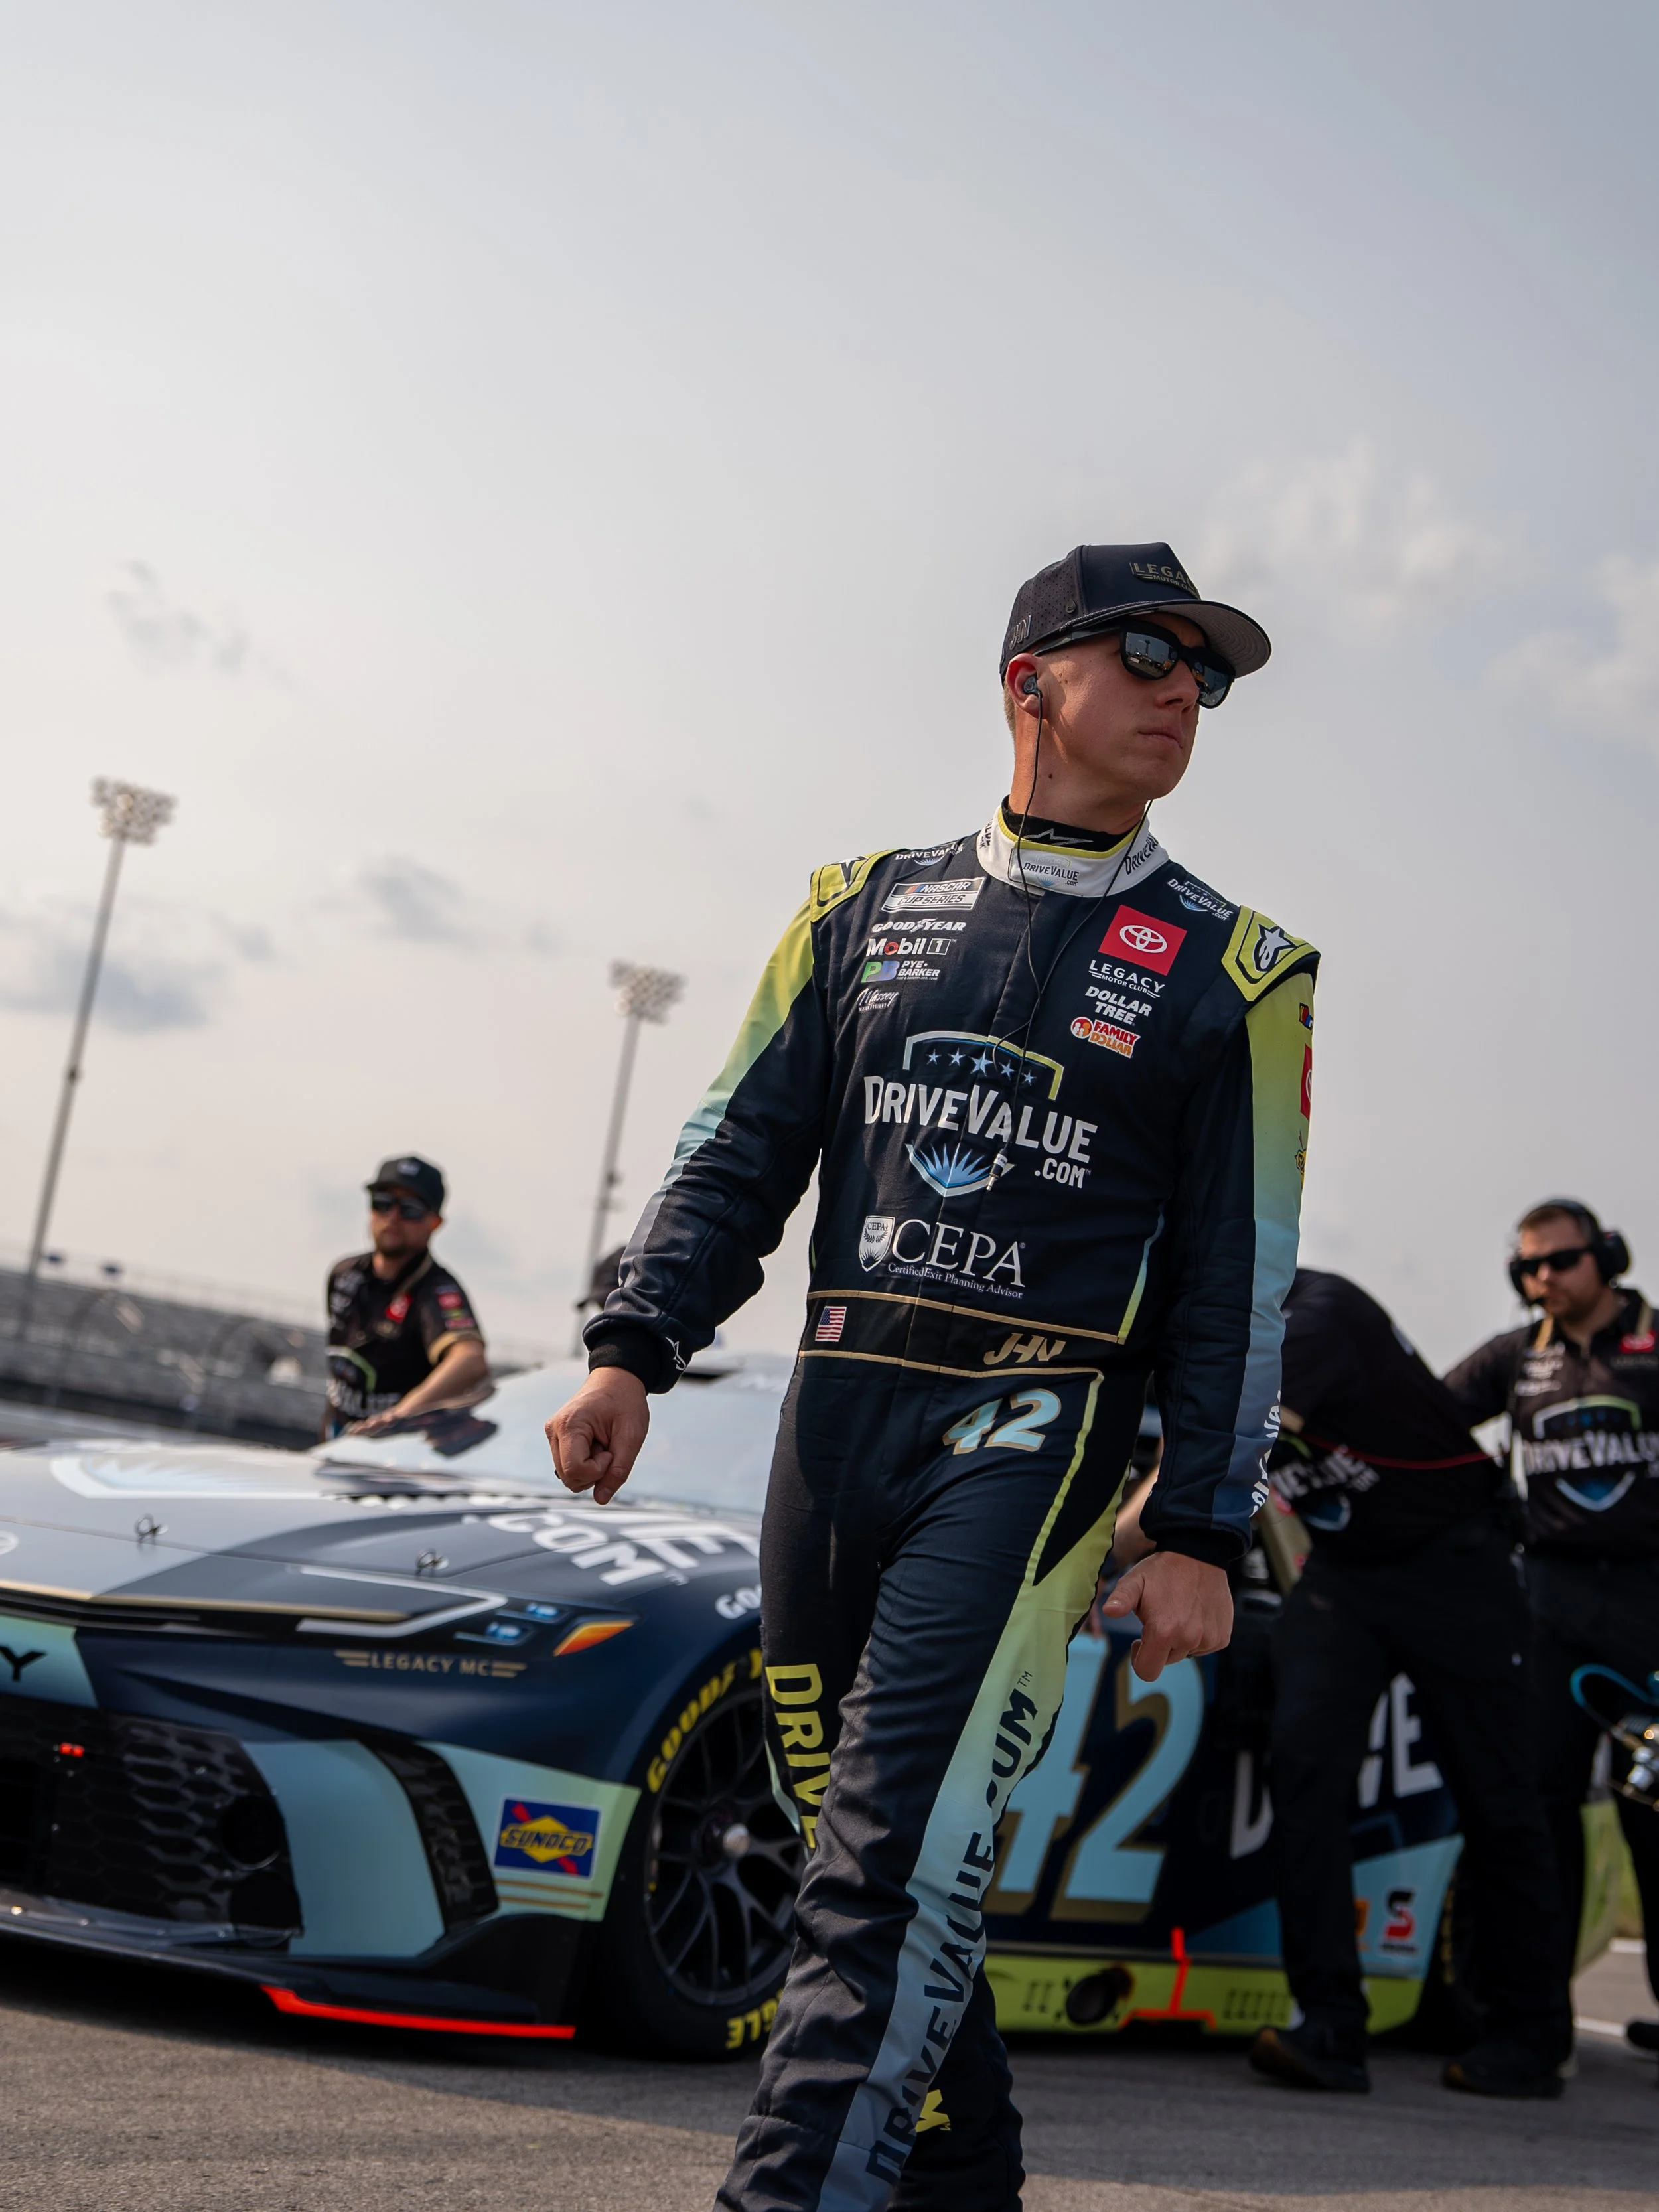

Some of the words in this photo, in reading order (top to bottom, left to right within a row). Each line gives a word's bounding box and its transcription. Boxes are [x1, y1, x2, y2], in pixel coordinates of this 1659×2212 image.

[1153, 575, 1181, 587] MOTOR
[1023, 862, 1080, 881] DRIVEVALUE
[920, 881, 972, 893] NASCAR
[1167, 878, 1234, 918] DRIVEVALUE
[897, 895, 922, 905] CUP
[922, 895, 965, 905] SERIES
[871, 917, 968, 933] GOODYEAR
[865, 938, 927, 957] Mobil
[897, 968, 941, 977] BARKER
[1089, 960, 1166, 994] LEGACY
[1101, 974, 1128, 987] MOTOR
[1129, 983, 1148, 994] CLUB
[1085, 986, 1153, 1017] DOLLAR
[1095, 1001, 1137, 1025] TREE
[1090, 1031, 1133, 1057] DOLLAR
[1094, 1020, 1139, 1045] FAMILY
[863, 1075, 1098, 1163] DRIVEVALUE
[867, 1221, 885, 1231] CEPA
[892, 1218, 1026, 1288] CEPA
[944, 1273, 985, 1293] Planning
[986, 1284, 1023, 1299] Advisor
[942, 1388, 1062, 1455] 42
[370, 1651, 453, 1674] LEGACY
[459, 1660, 490, 1676] MC
[505, 1828, 588, 1854] SUNOCO
